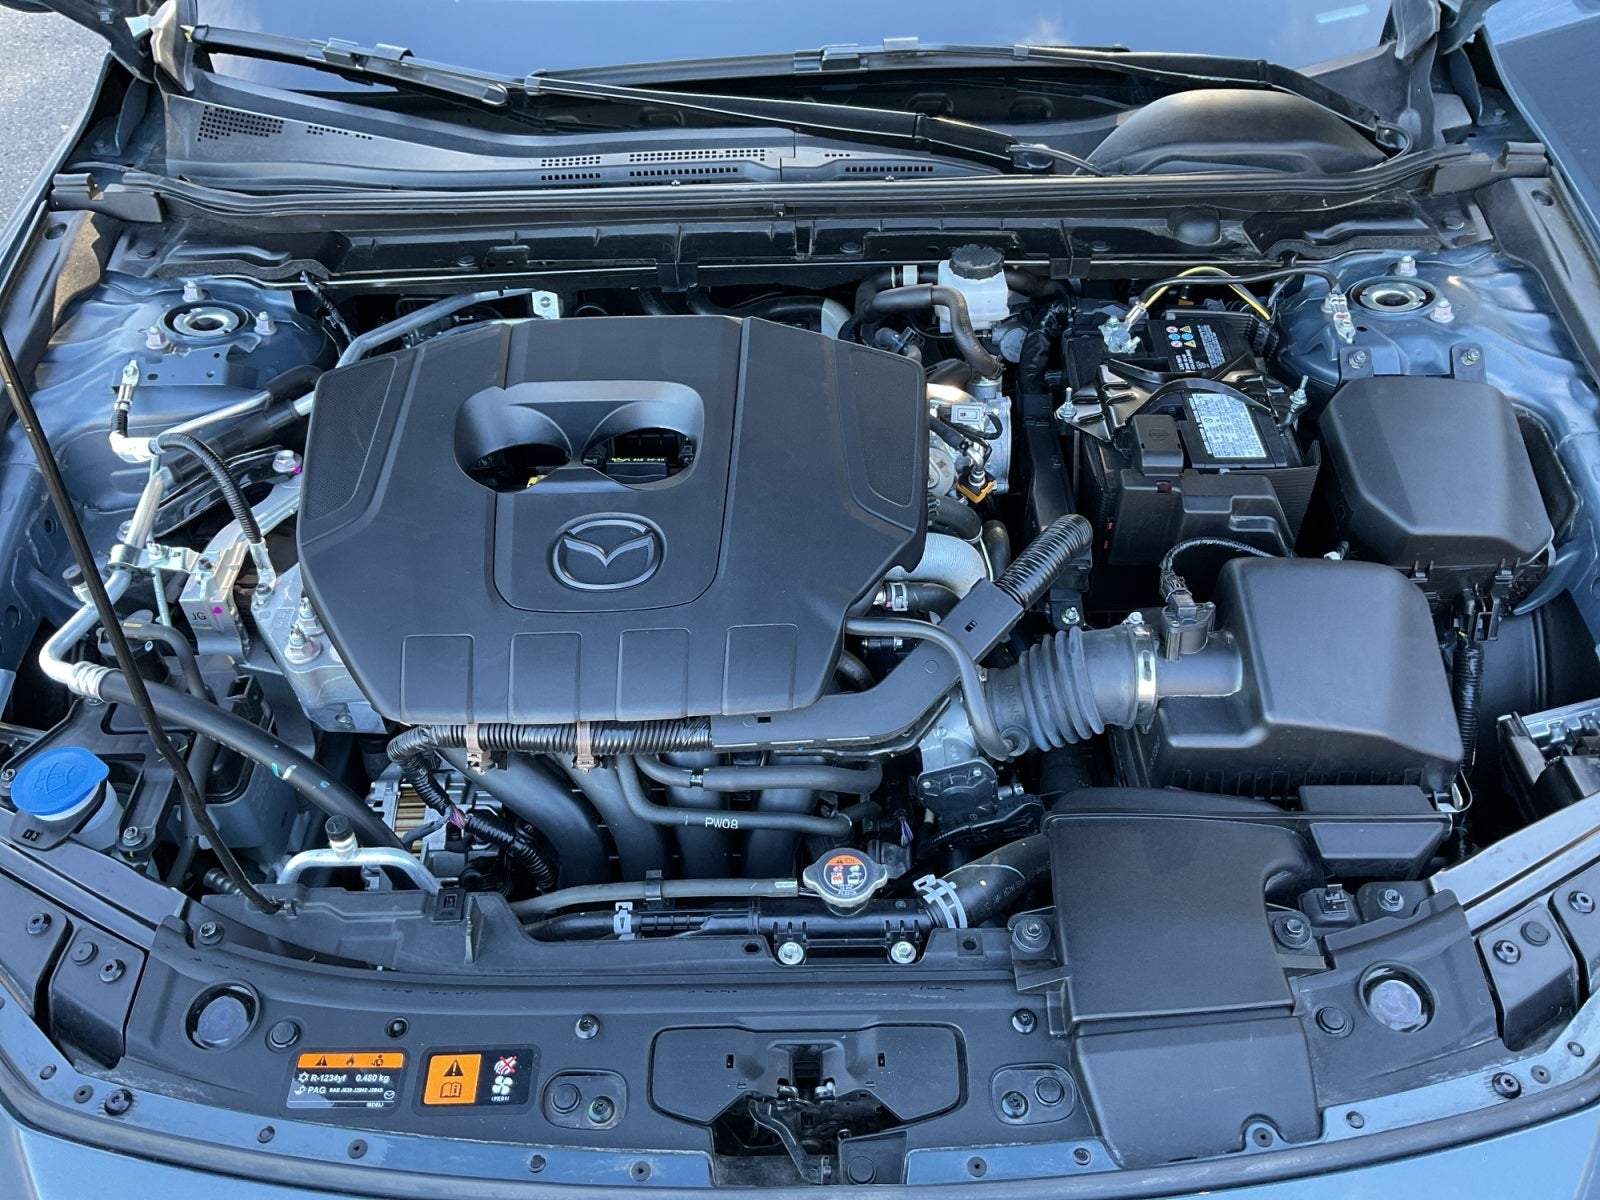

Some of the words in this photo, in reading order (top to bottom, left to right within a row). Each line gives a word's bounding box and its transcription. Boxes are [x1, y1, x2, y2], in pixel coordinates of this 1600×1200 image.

[192, 612, 207, 620] JG
[705, 816, 739, 829] PW08
[310, 1074, 347, 1083] R-1234yf
[355, 1074, 378, 1082] 0.480
[378, 1074, 390, 1083] kg
[307, 1086, 327, 1094] PAG
